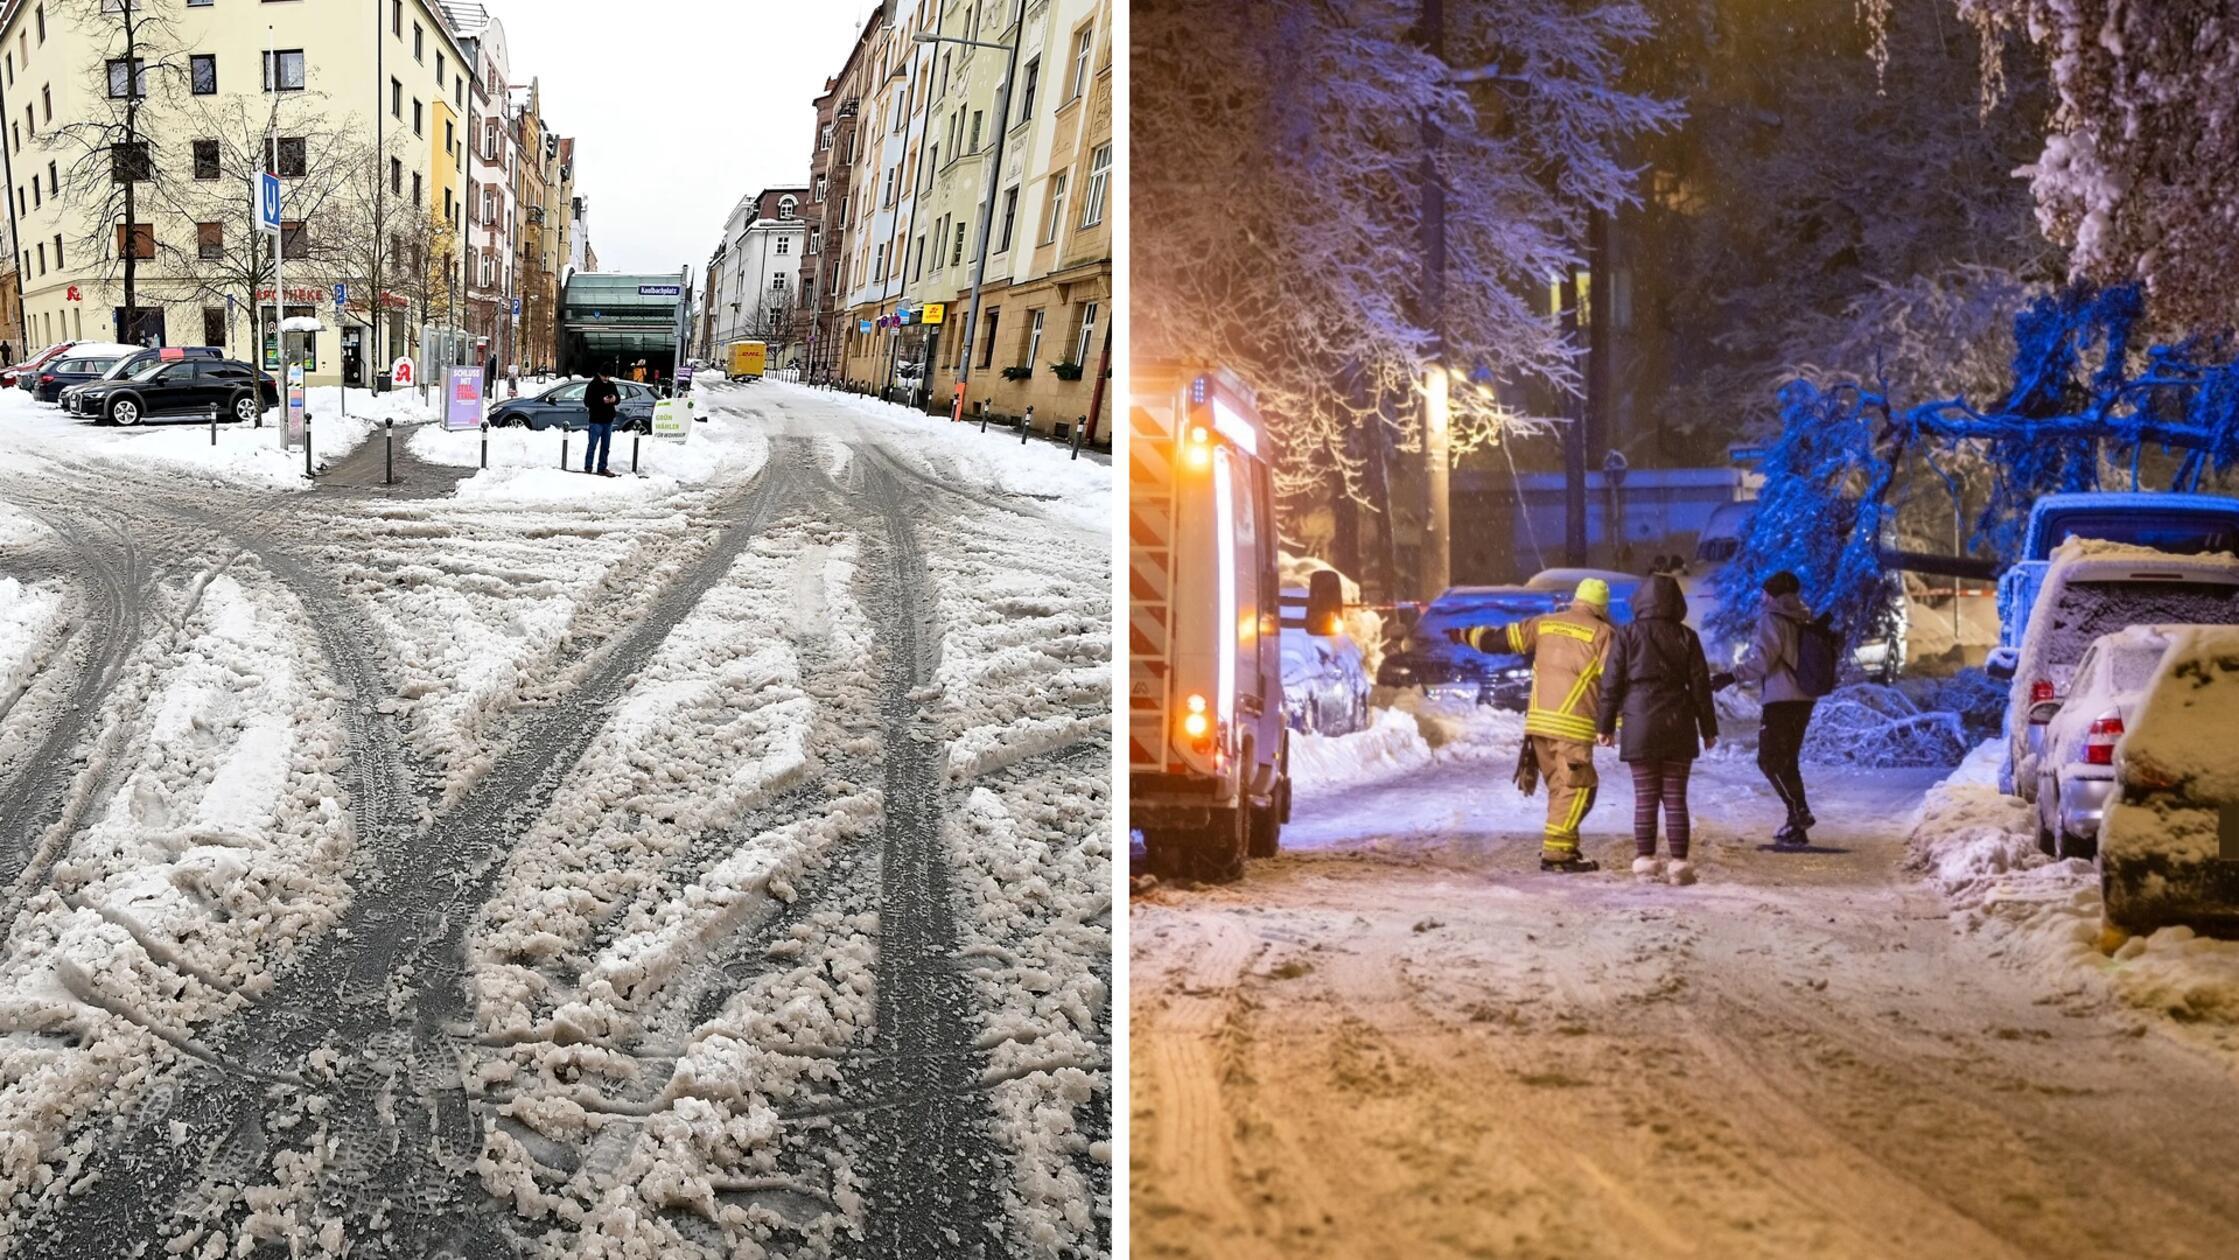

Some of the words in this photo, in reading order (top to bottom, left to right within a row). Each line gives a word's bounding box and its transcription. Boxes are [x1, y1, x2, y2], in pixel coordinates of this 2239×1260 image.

[266, 183, 276, 220] U
[640, 286, 678, 295] Kaulbachplatz
[453, 369, 480, 378] SCHLUSS
